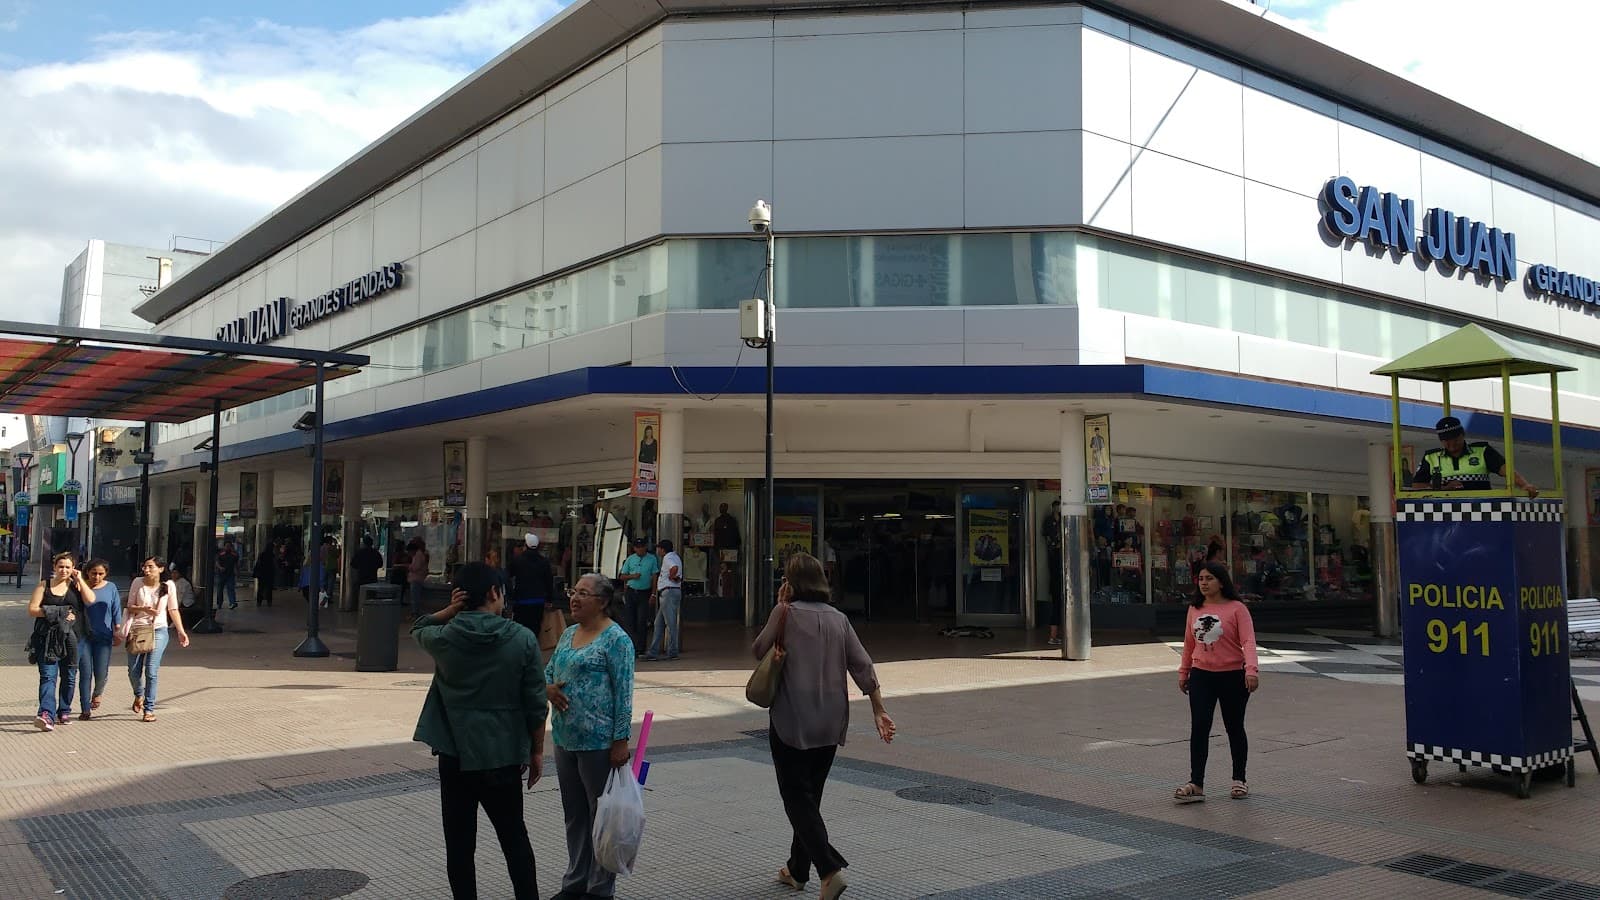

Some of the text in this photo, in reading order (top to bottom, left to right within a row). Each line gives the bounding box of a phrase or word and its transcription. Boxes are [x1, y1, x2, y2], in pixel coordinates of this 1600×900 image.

[1333, 175, 1416, 253] SAN
[1427, 207, 1517, 281] JUAN
[242, 299, 282, 344] JUAN
[289, 288, 341, 328] GRANDES
[343, 262, 397, 306] TIENDAS
[101, 487, 112, 500] LAS
[1409, 583, 1504, 610] POLICIA
[1520, 585, 1564, 610] POLICIA
[1426, 619, 1490, 657] 911
[1530, 620, 1560, 657] 911
